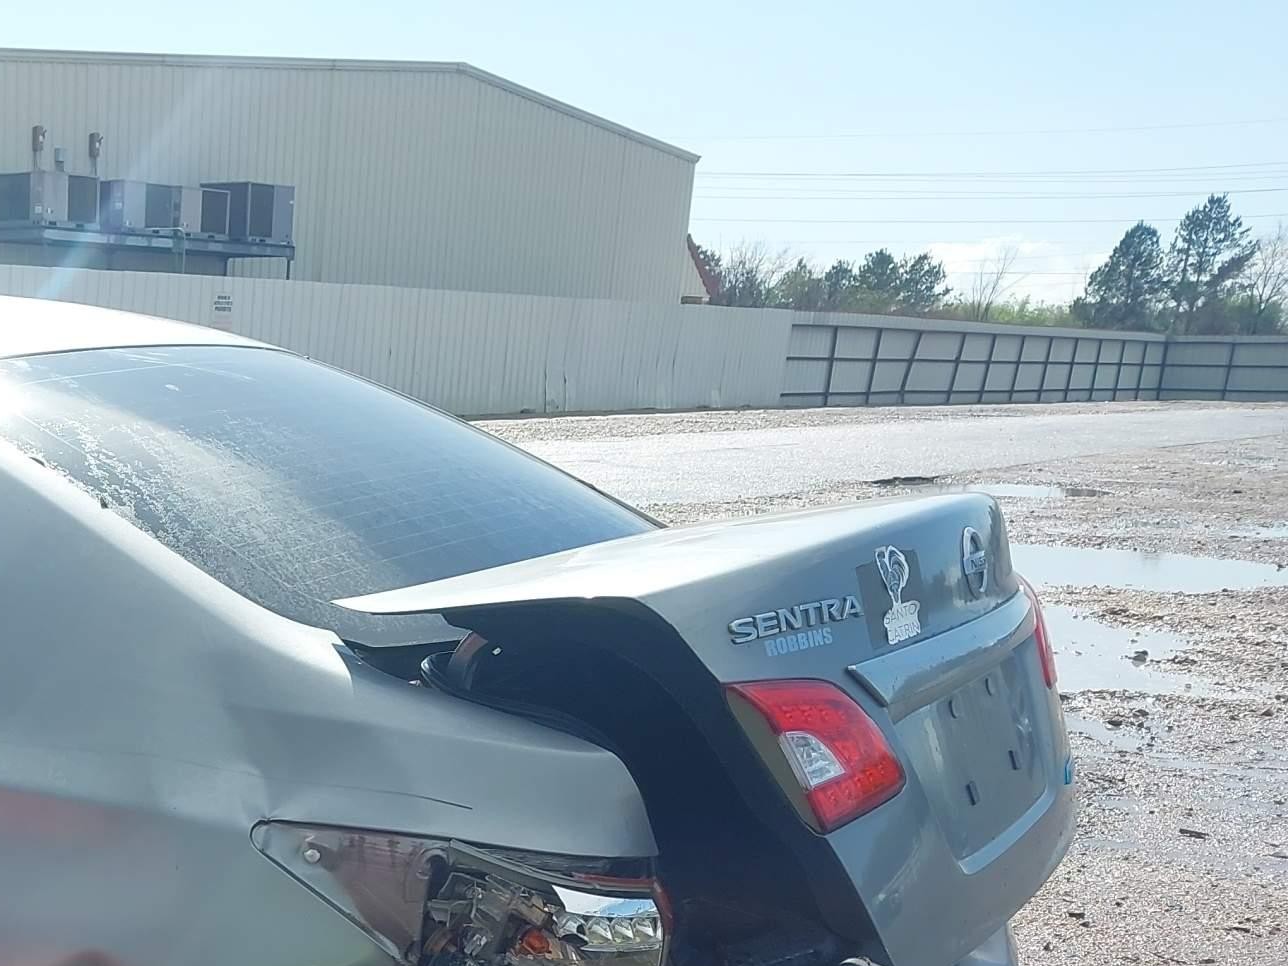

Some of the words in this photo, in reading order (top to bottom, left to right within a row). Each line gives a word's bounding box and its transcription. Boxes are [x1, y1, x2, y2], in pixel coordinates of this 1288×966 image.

[728, 595, 863, 644] SENTRA
[885, 603, 917, 625] SANTO
[765, 627, 833, 657] ROBBINS
